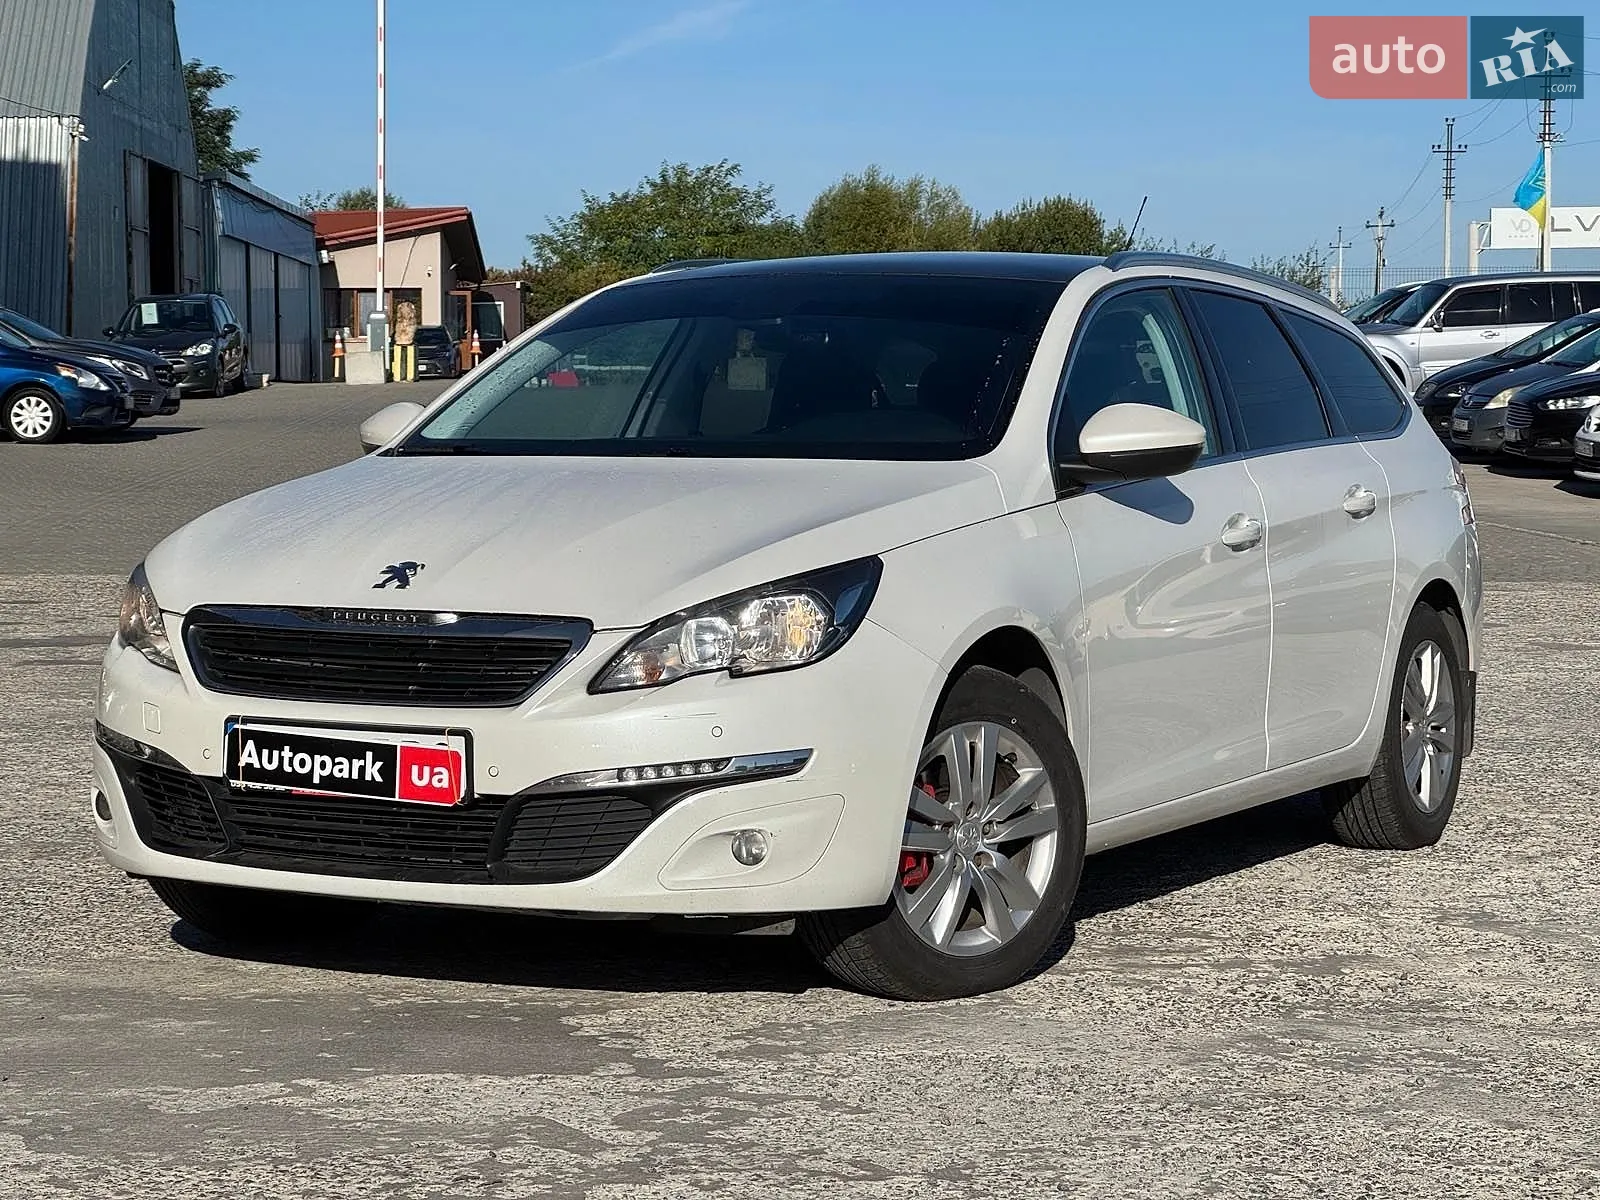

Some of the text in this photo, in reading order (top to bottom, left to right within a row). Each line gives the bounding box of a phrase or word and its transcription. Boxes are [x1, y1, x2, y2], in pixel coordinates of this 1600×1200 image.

[332, 611, 419, 623] PEUGEOT
[239, 739, 449, 789] Autopark ua
